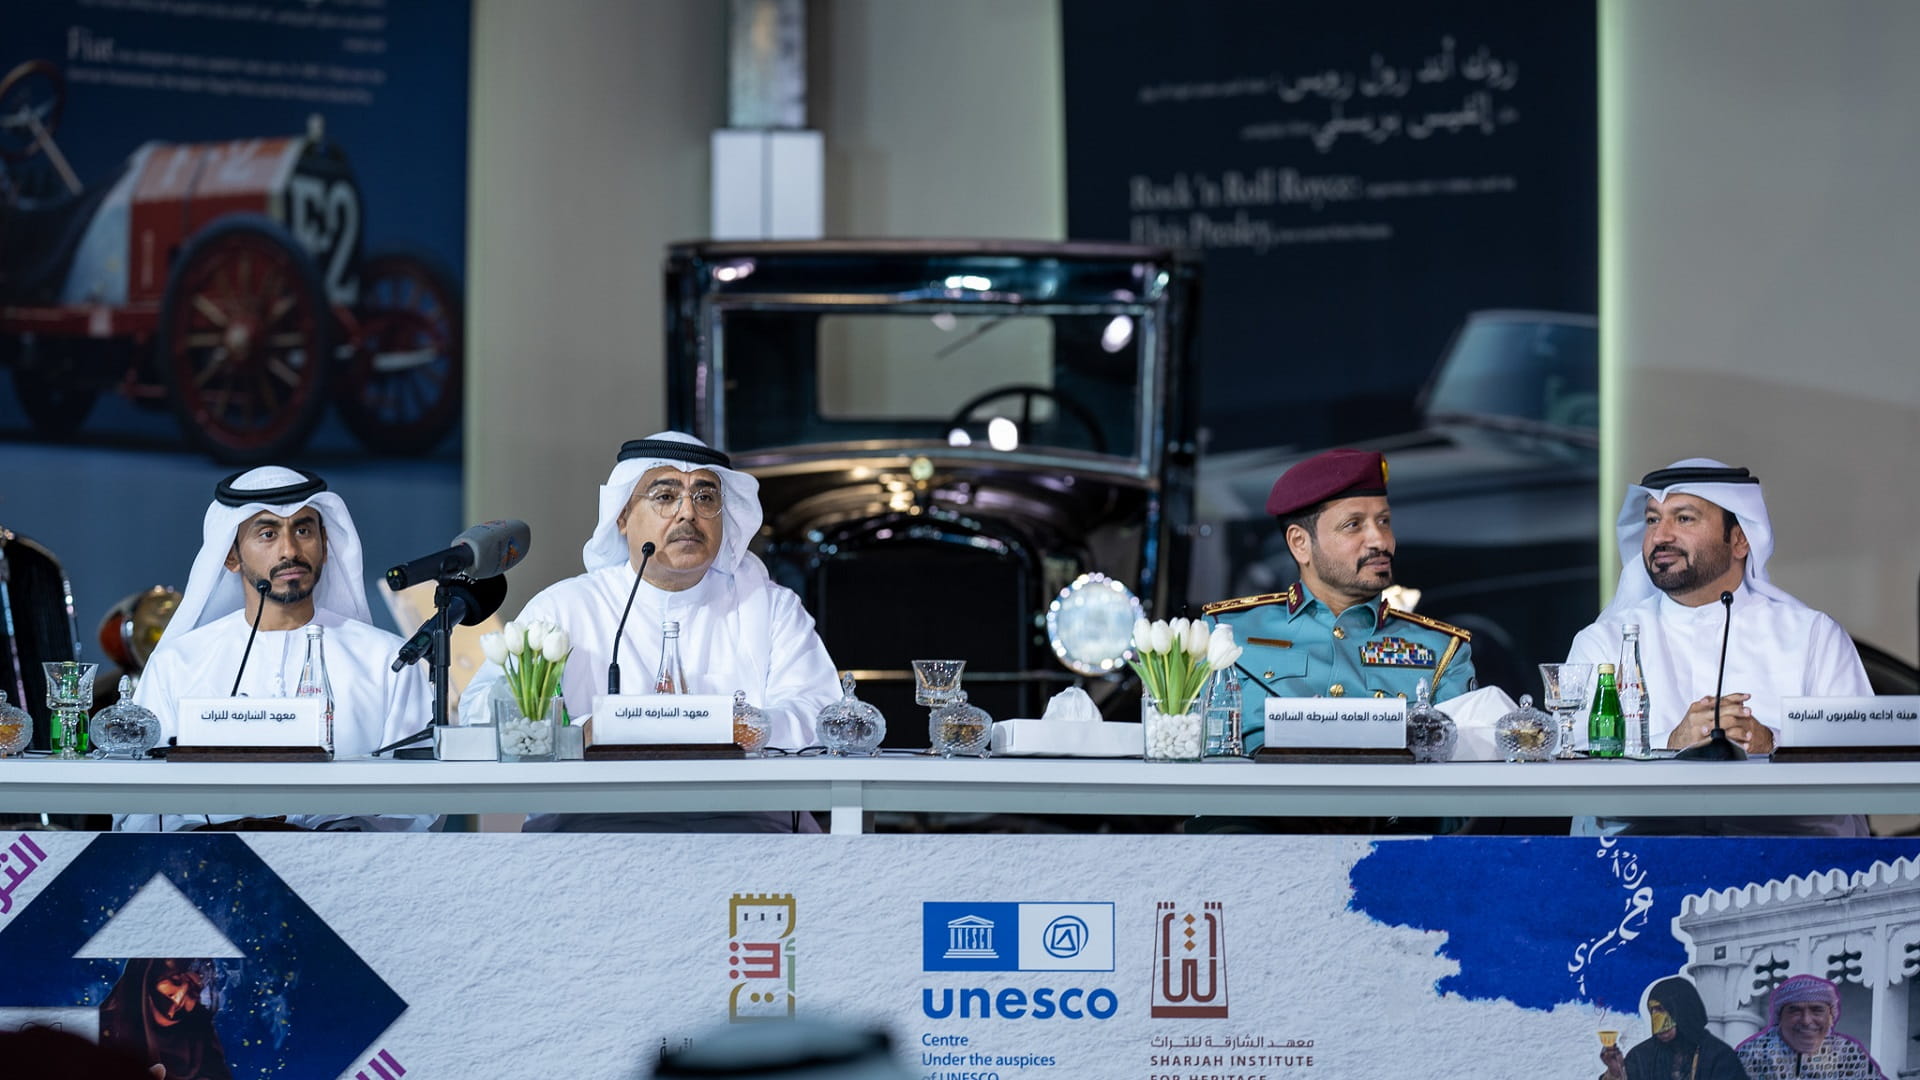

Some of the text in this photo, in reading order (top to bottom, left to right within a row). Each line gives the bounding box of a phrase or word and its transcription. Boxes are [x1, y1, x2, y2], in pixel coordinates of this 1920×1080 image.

[269, 711, 296, 722] معهد
[682, 708, 709, 719] معهد
[923, 987, 1118, 1019] unesco
[922, 1033, 969, 1046] Centre
[1150, 1034, 1314, 1051] معهد الشارقة للتراث
[922, 1053, 1056, 1069] Under the auspices
[1150, 1055, 1314, 1067] SHARJAH INSTITUTE
